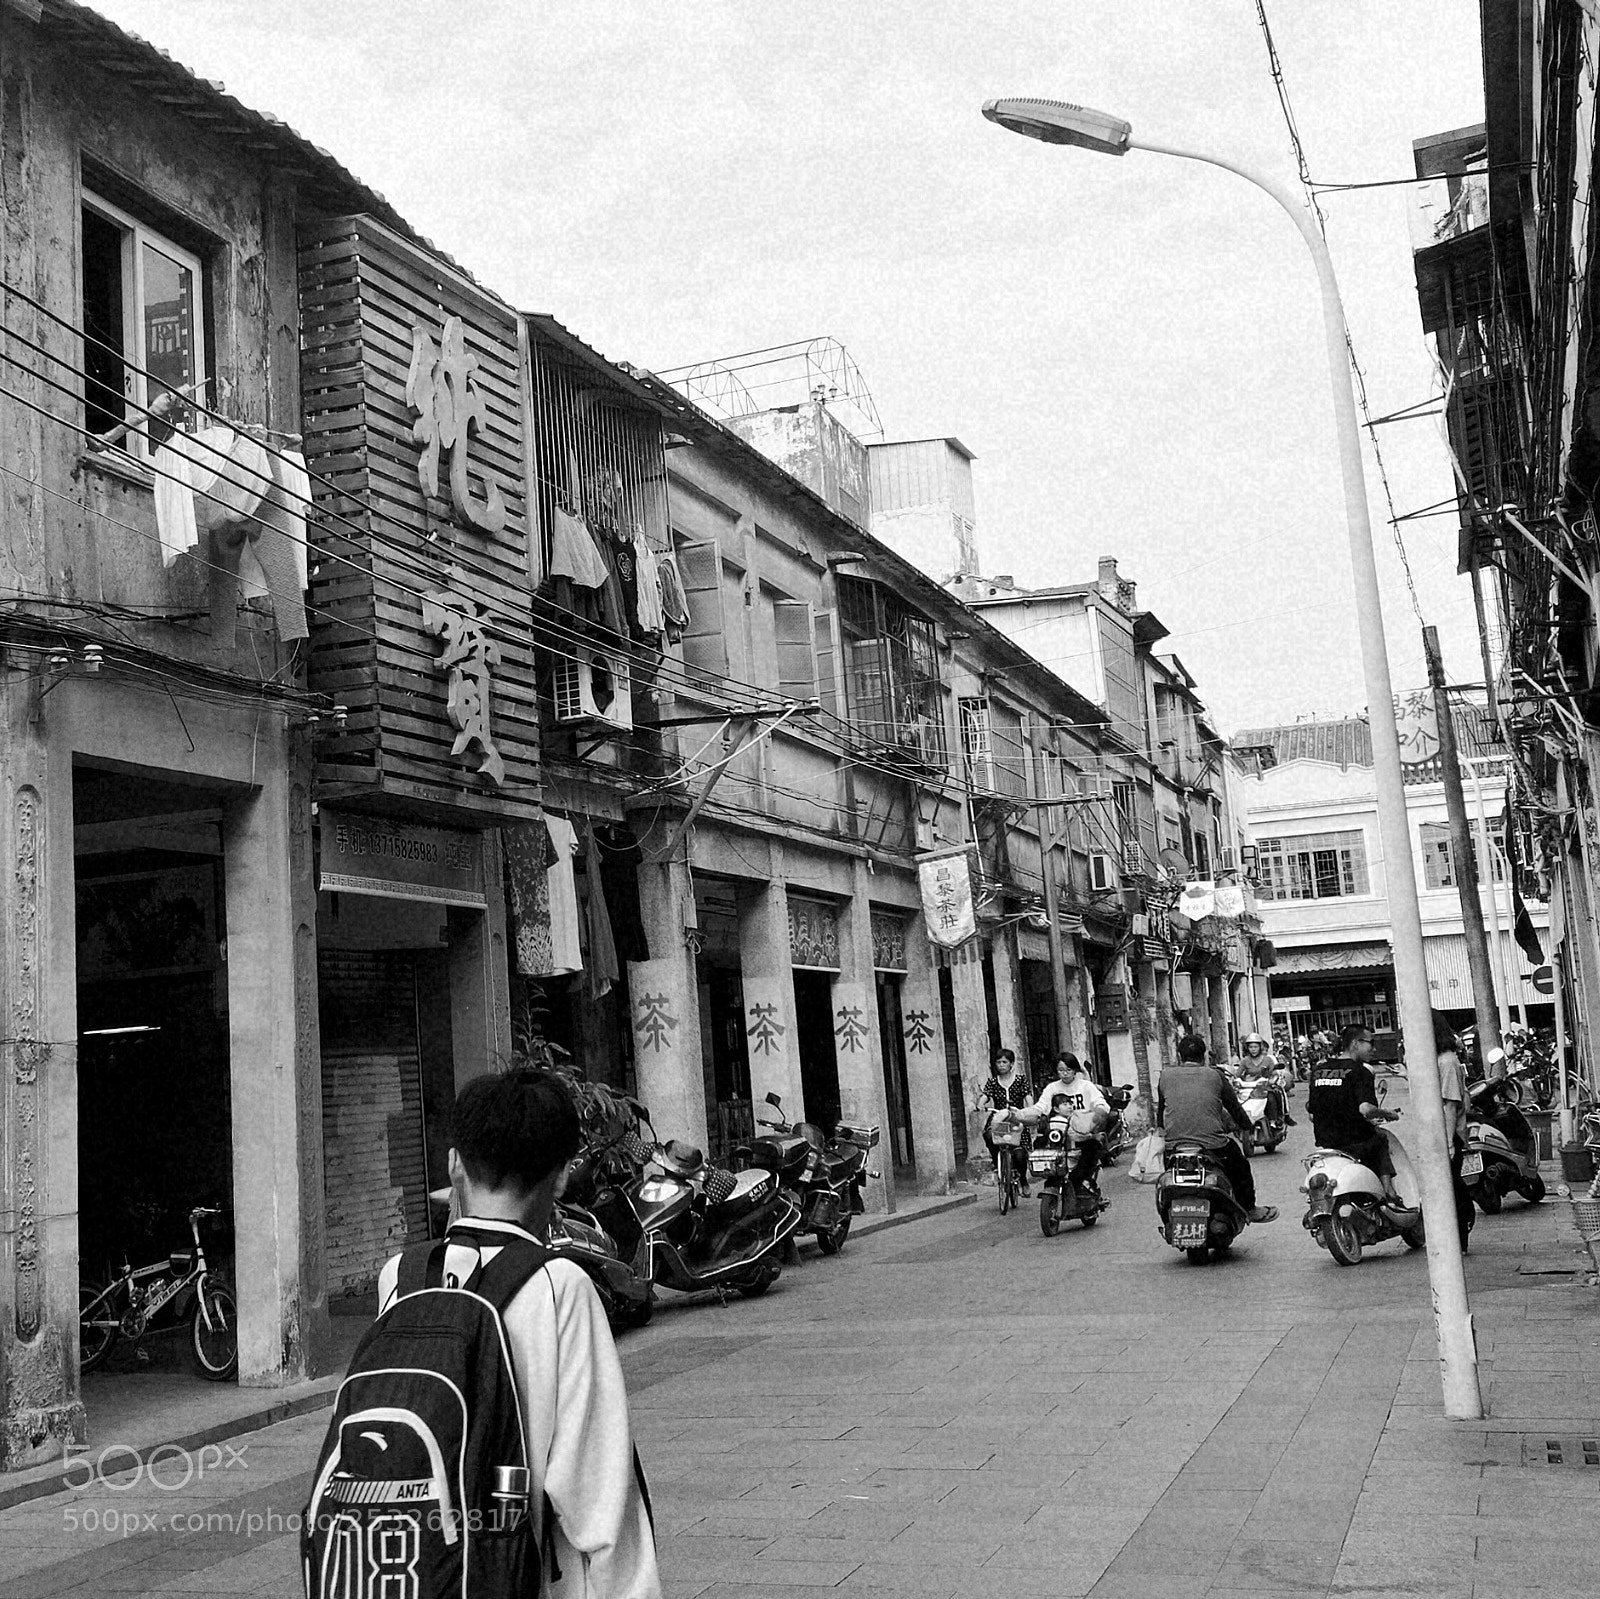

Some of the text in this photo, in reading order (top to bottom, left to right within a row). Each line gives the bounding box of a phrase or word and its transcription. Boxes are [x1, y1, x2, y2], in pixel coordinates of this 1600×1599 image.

[369, 833, 438, 864] 13715825983
[635, 992, 680, 1053] 茶
[747, 1003, 786, 1056] 茶
[835, 1005, 870, 1053] 茶
[904, 1009, 935, 1055] 茶
[1313, 1068, 1352, 1079] STAY
[396, 1482, 430, 1499] ANTA
